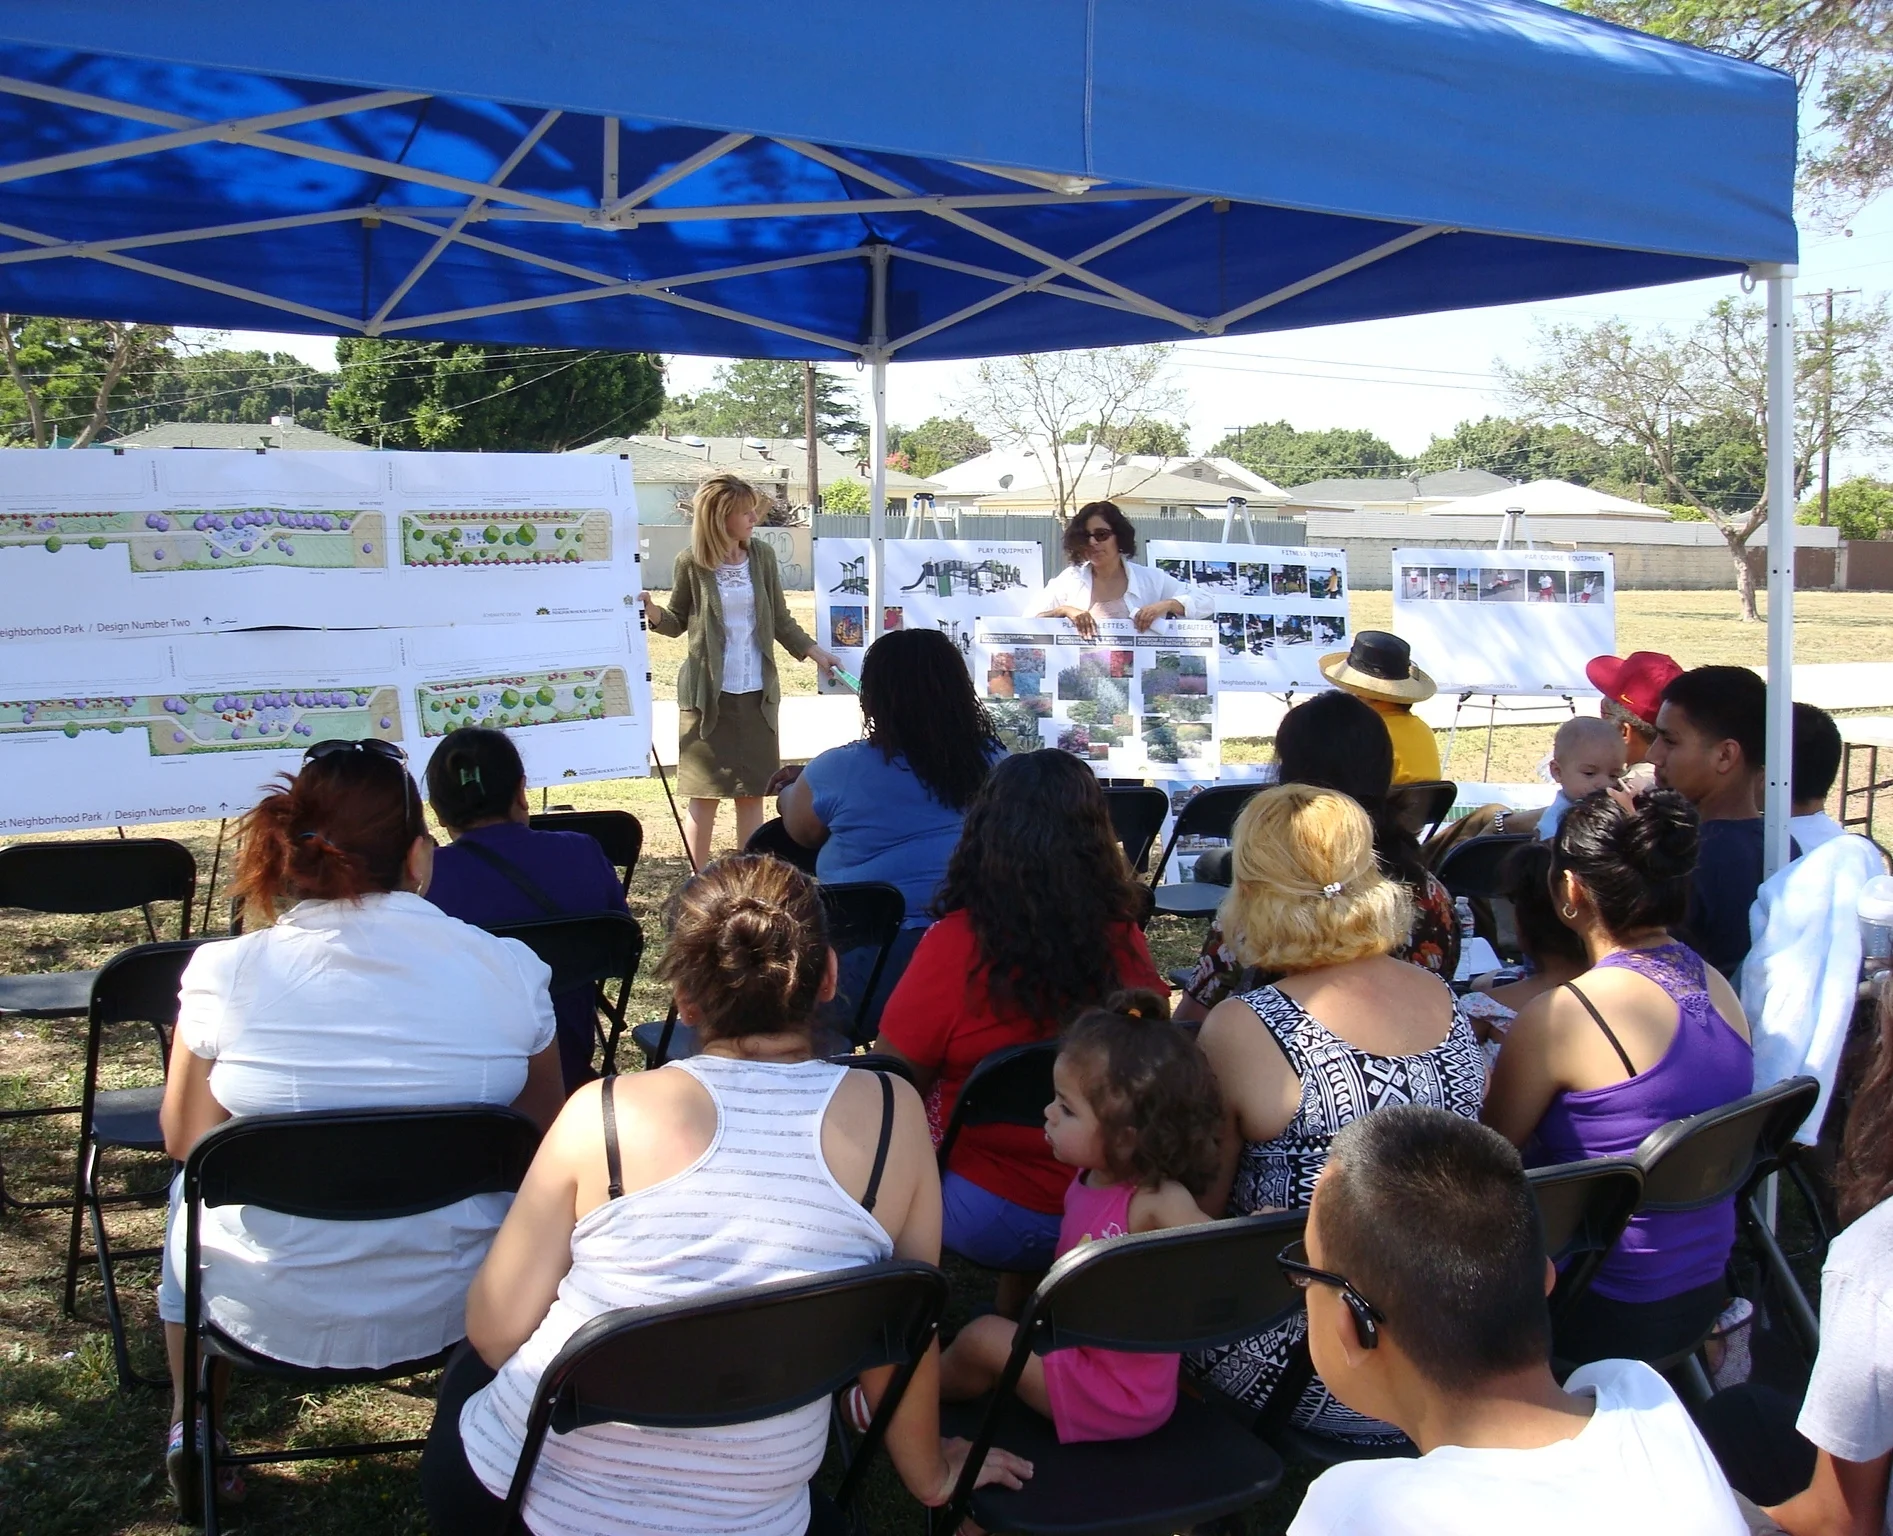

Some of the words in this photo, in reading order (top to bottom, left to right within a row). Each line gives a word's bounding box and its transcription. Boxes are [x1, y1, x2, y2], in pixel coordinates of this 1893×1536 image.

[997, 547, 1033, 555] EQUIPMENT
[0, 621, 61, 640] eighborhood
[63, 623, 85, 635] Park
[97, 622, 129, 634] Design
[131, 620, 169, 630] Number
[170, 618, 191, 628] Two
[9, 813, 80, 828] Neighborhood
[82, 811, 103, 822] Park
[115, 809, 147, 820] Design
[149, 806, 186, 817] Number
[187, 804, 207, 814] One
